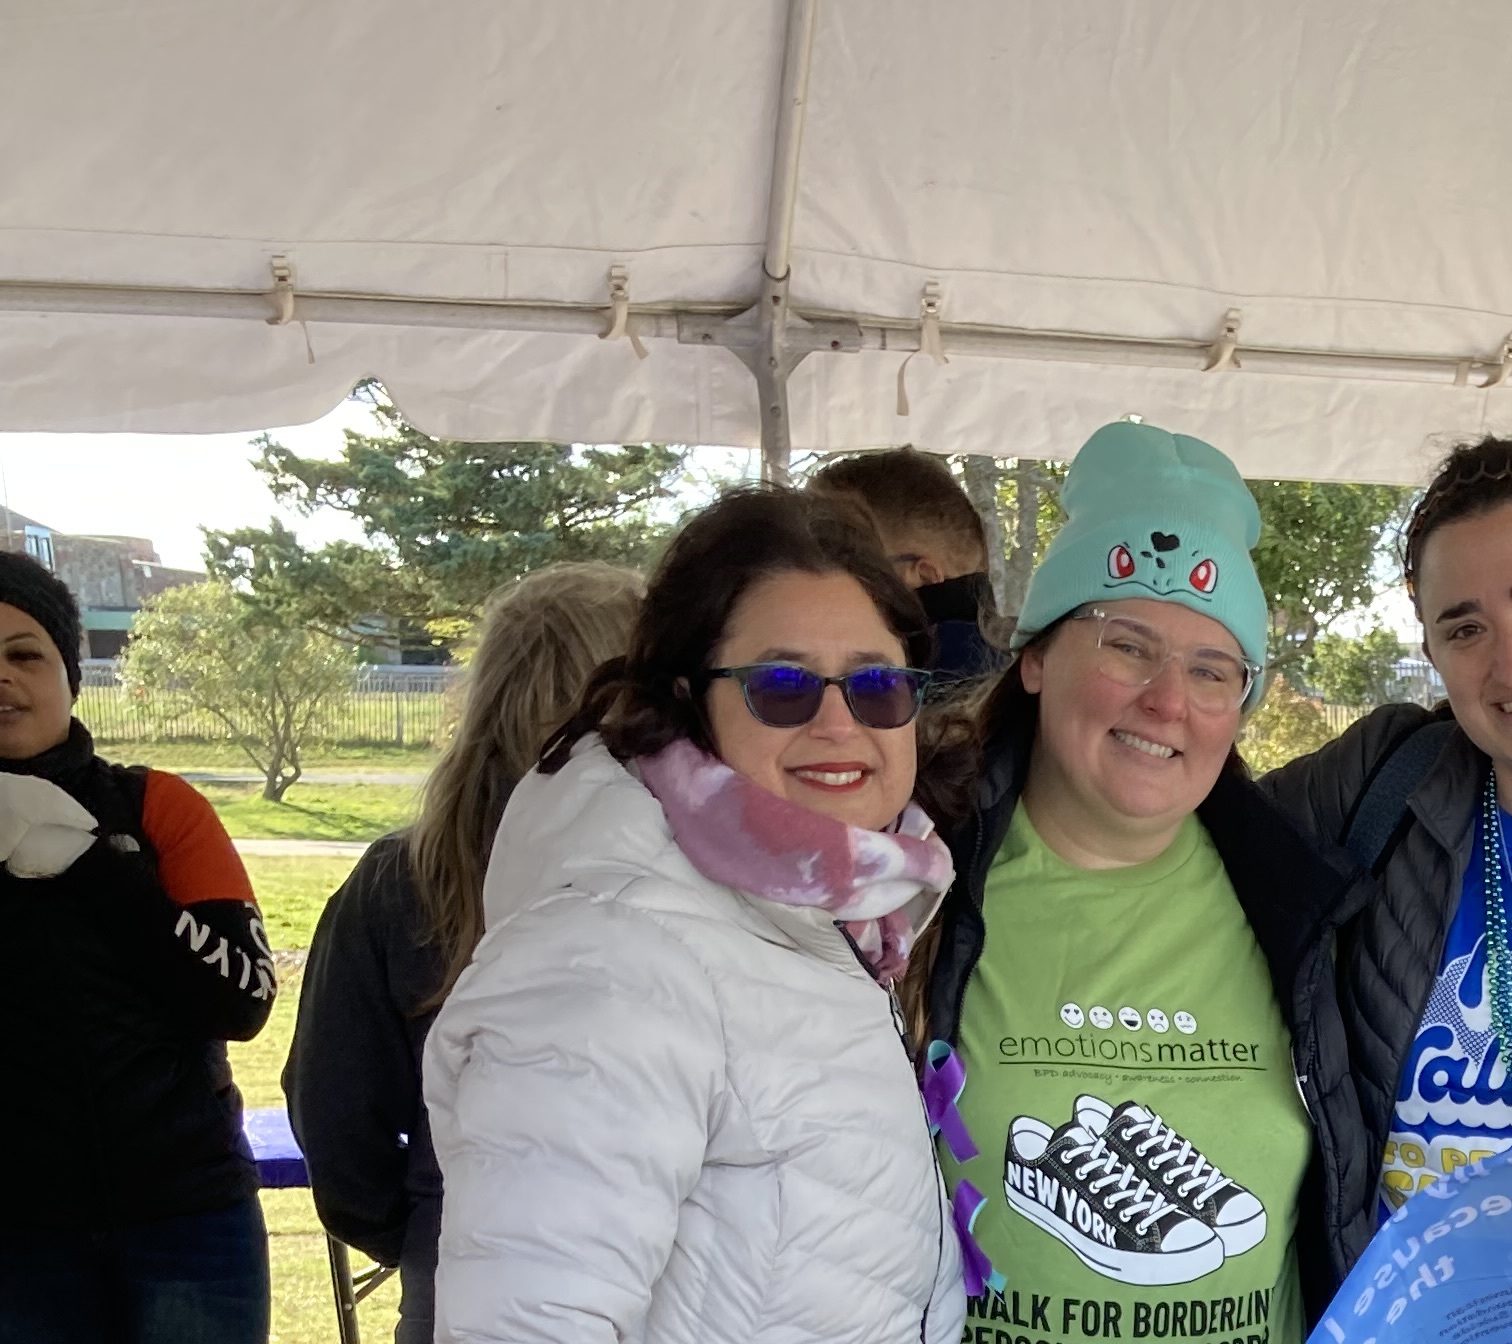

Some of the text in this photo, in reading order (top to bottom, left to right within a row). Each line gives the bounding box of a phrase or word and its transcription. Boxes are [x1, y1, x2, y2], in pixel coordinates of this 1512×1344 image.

[999, 1033, 1260, 1063] emotionsmatter
[1007, 1160, 1118, 1249] NEW YORK
[966, 1285, 1052, 1333] WALK
[1062, 1298, 1122, 1338] FOR
